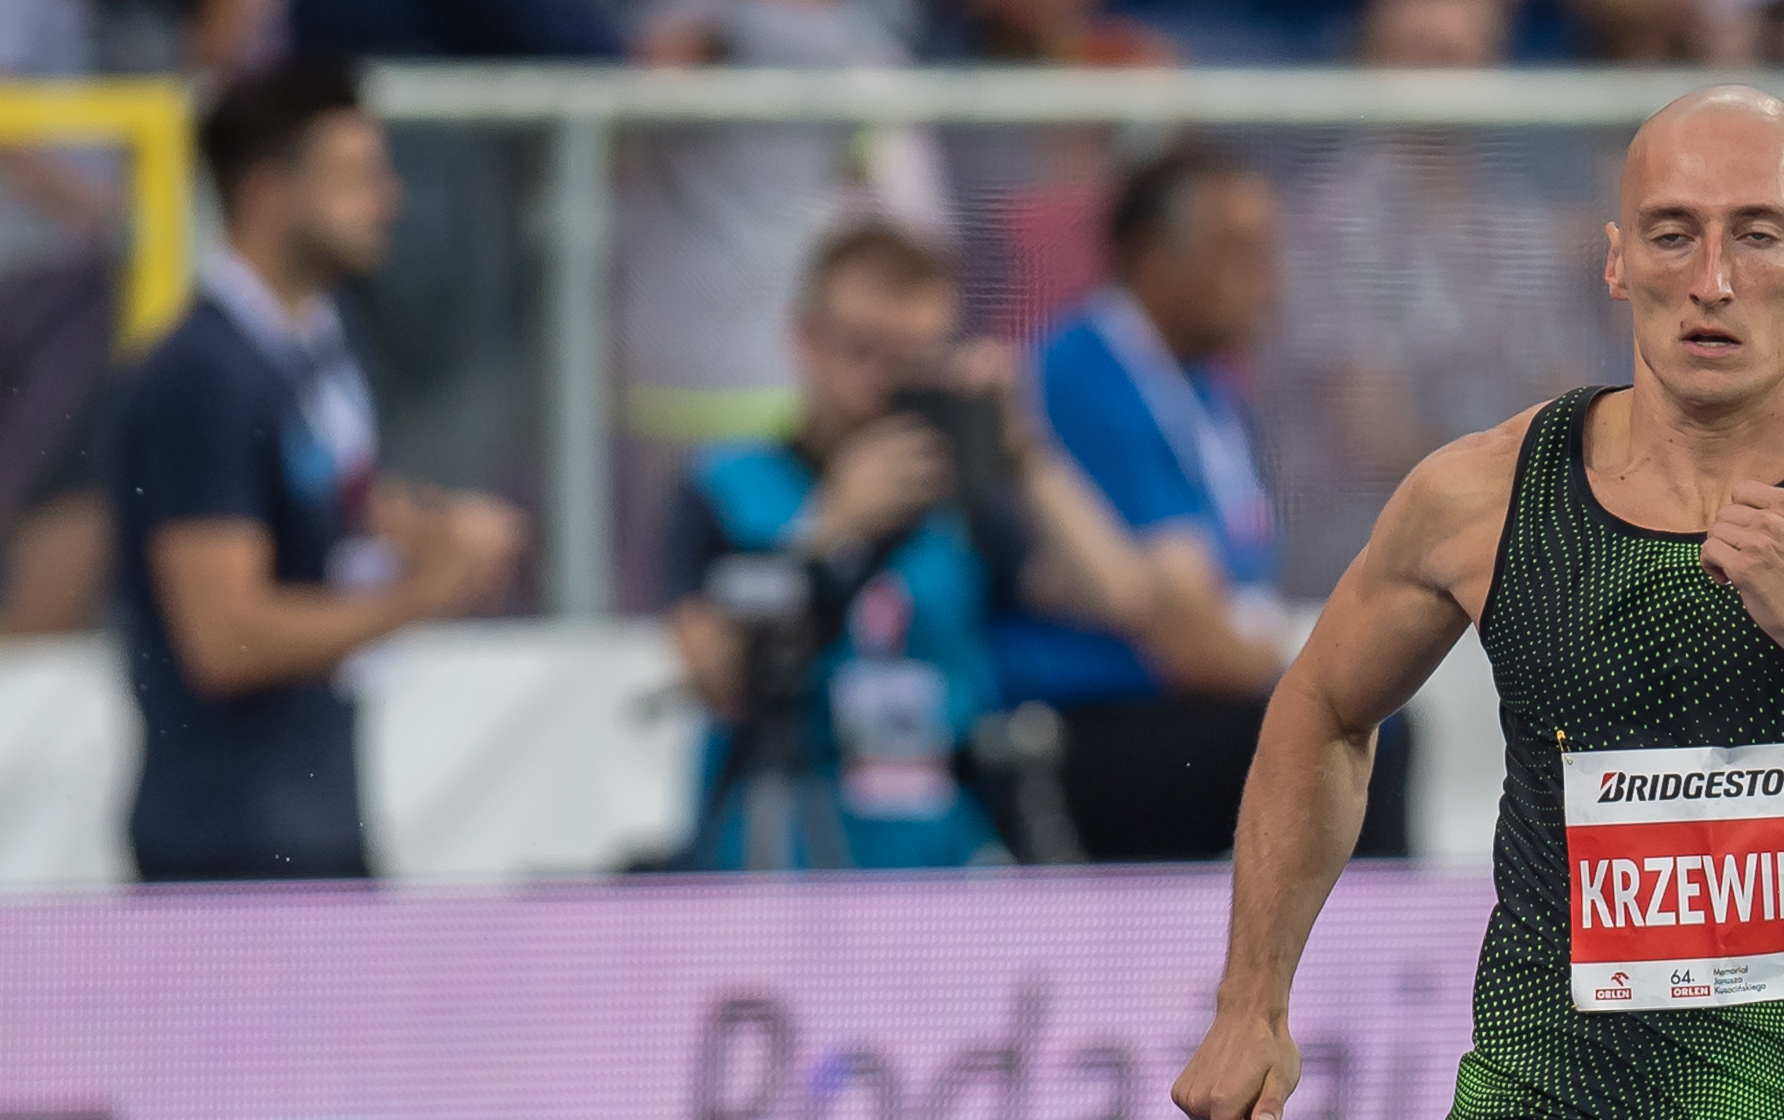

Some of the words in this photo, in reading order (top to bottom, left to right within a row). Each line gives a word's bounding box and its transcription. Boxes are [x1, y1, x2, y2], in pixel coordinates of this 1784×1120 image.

[1671, 968, 1695, 984] 64.
[1596, 989, 1630, 999] ORLEN
[1673, 986, 1709, 997] ORLEN
